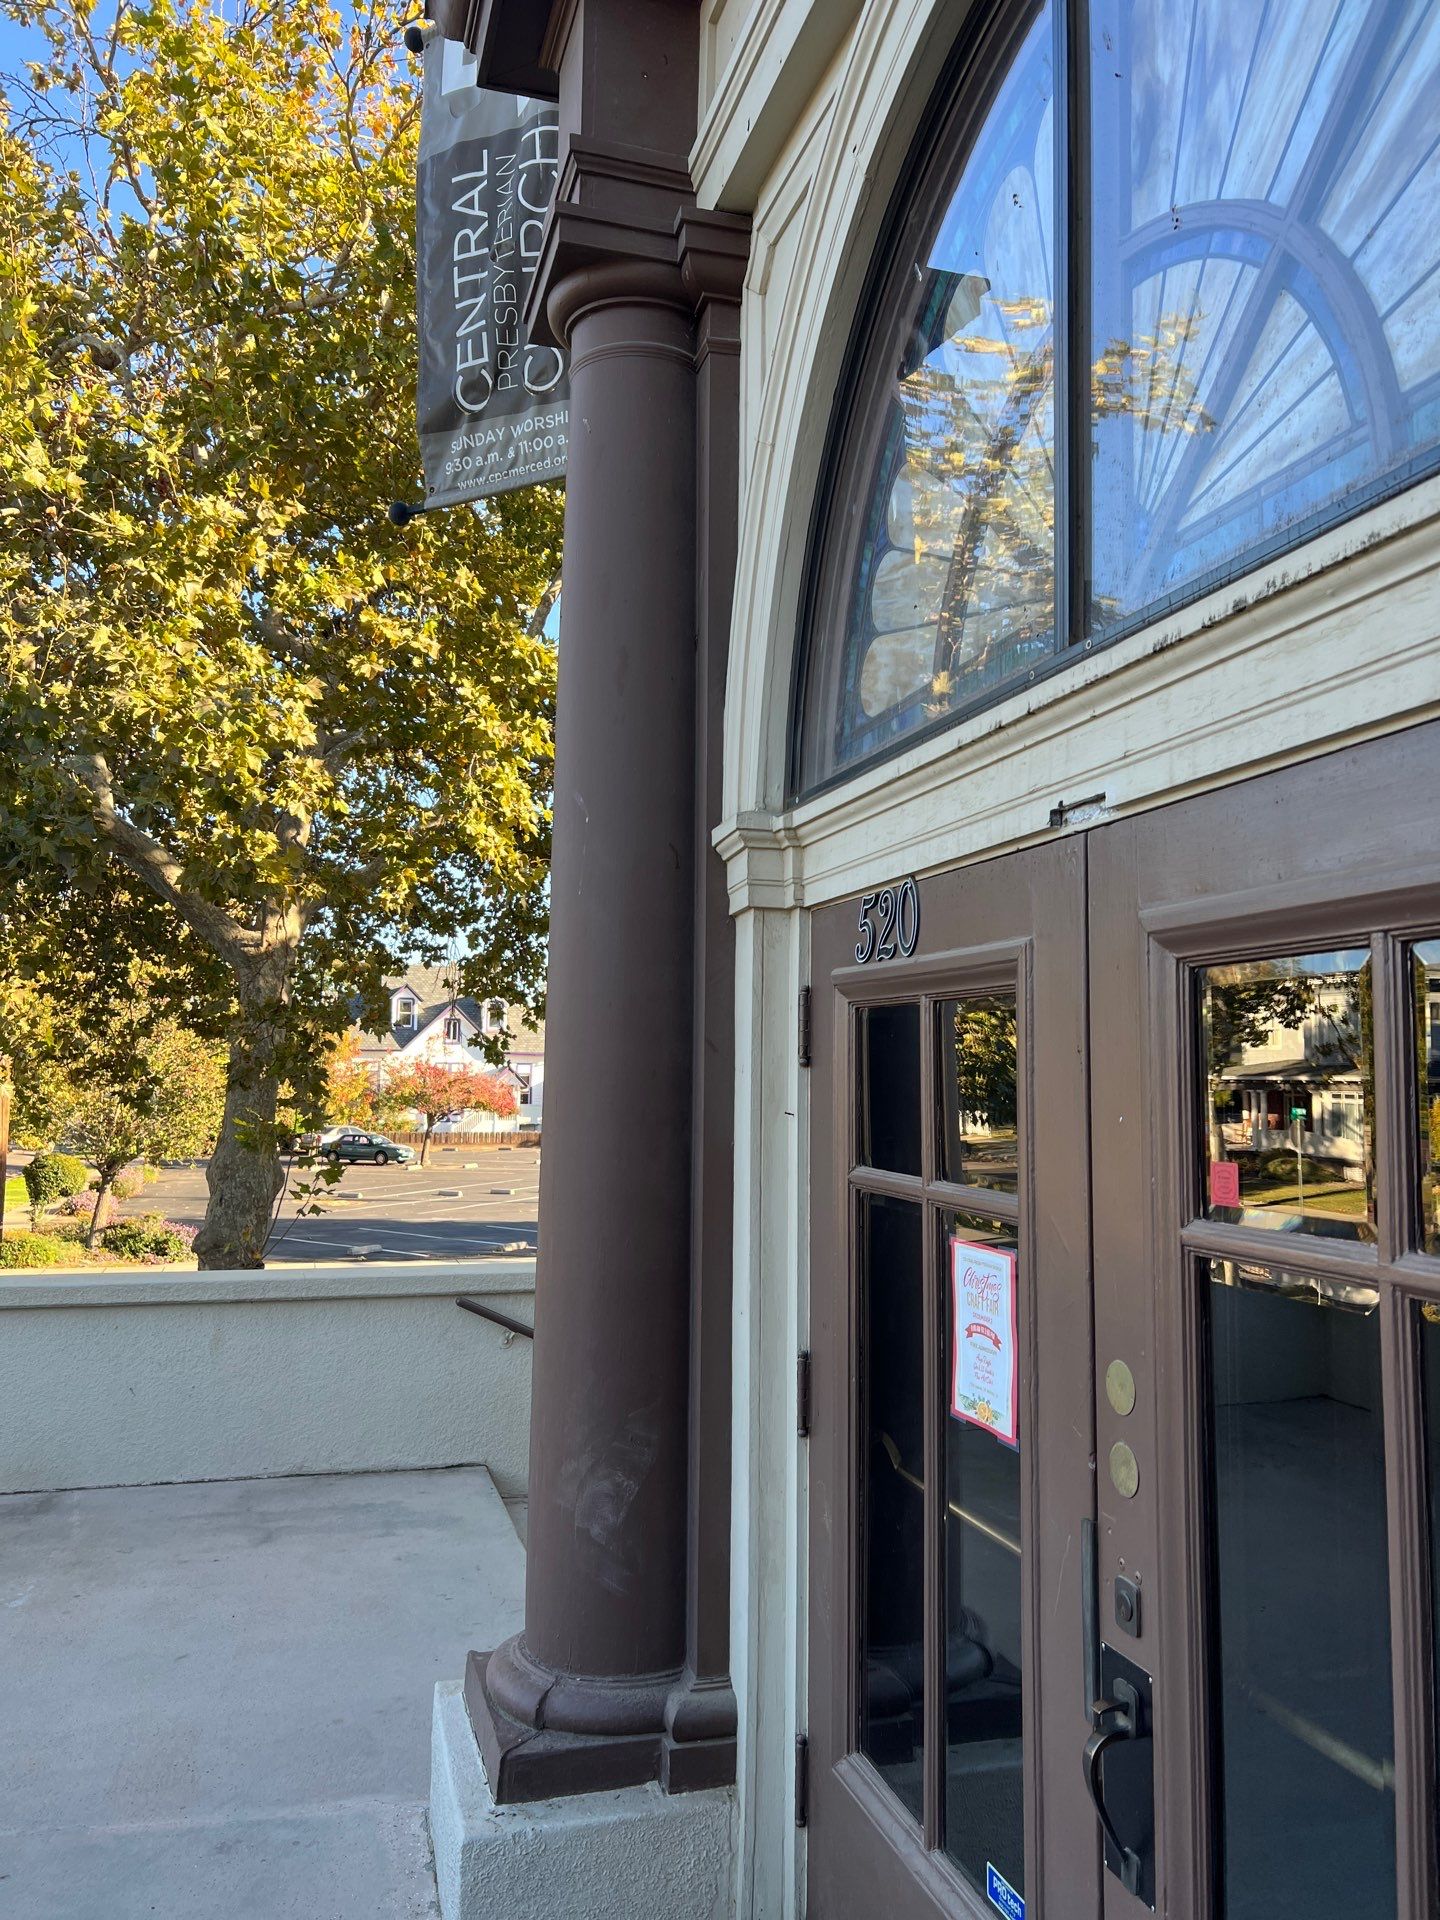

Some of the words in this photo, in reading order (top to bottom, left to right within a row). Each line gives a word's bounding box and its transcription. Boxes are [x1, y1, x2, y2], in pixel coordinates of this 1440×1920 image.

[452, 149, 493, 413] CENTRAL
[493, 153, 519, 391] PRESBYTERIAN
[518, 125, 563, 393] CCH
[451, 427, 506, 454] SUNDAY
[510, 410, 569, 439] WORSHI
[475, 451, 503, 467] a.m.
[507, 446, 515, 459] &
[518, 435, 554, 455] 11:00
[855, 877, 920, 964] 520
[963, 1266, 1002, 1302] Christmas
[966, 1291, 984, 1310] CRAFT
[986, 1296, 999, 1316] FAIR
